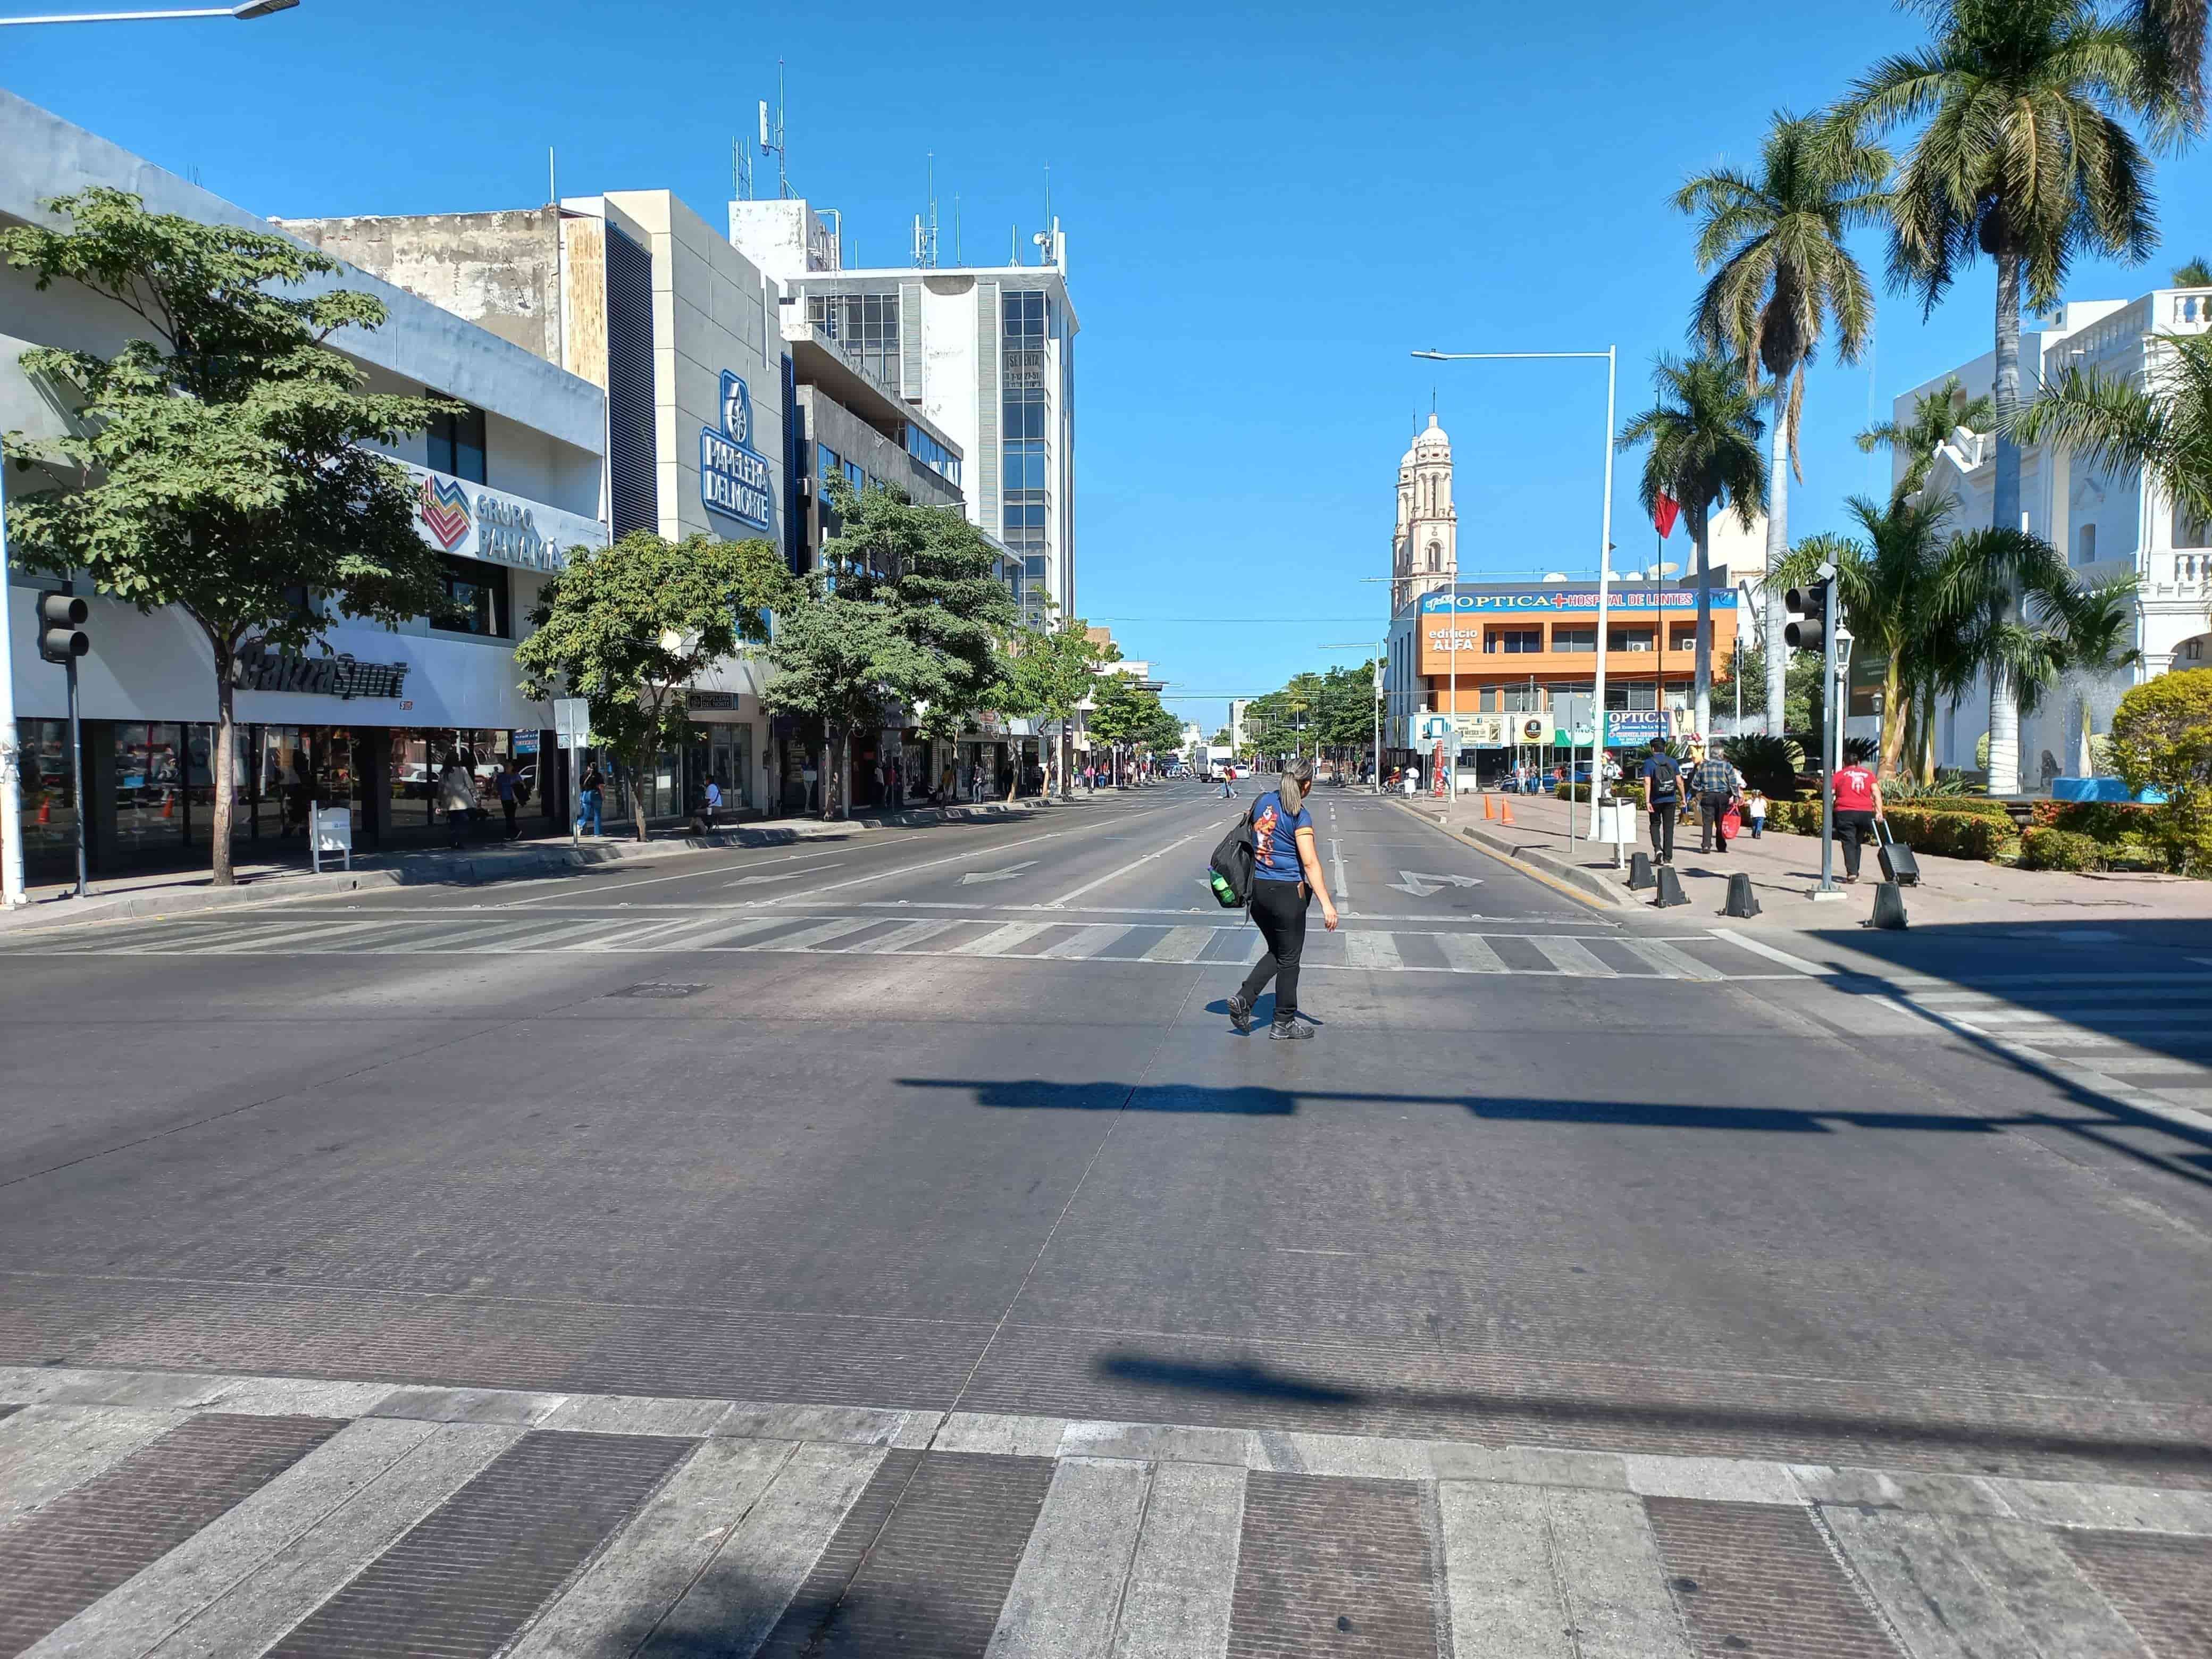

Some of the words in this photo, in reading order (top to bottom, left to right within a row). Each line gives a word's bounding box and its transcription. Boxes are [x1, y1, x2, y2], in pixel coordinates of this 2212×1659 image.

[706, 436, 767, 492] PAPELERA
[707, 471, 732, 508] DEL
[731, 481, 768, 523] NORTE
[477, 494, 533, 530] GRUPO
[1456, 596, 1551, 607] OPTICA
[1569, 593, 1625, 606] HOSPTAL
[1628, 594, 1645, 606] DE
[1648, 592, 1693, 606] LENTES
[1429, 629, 1478, 639] ediicio
[1433, 639, 1474, 651] ALFA
[1609, 713, 1667, 723] OPTICA
